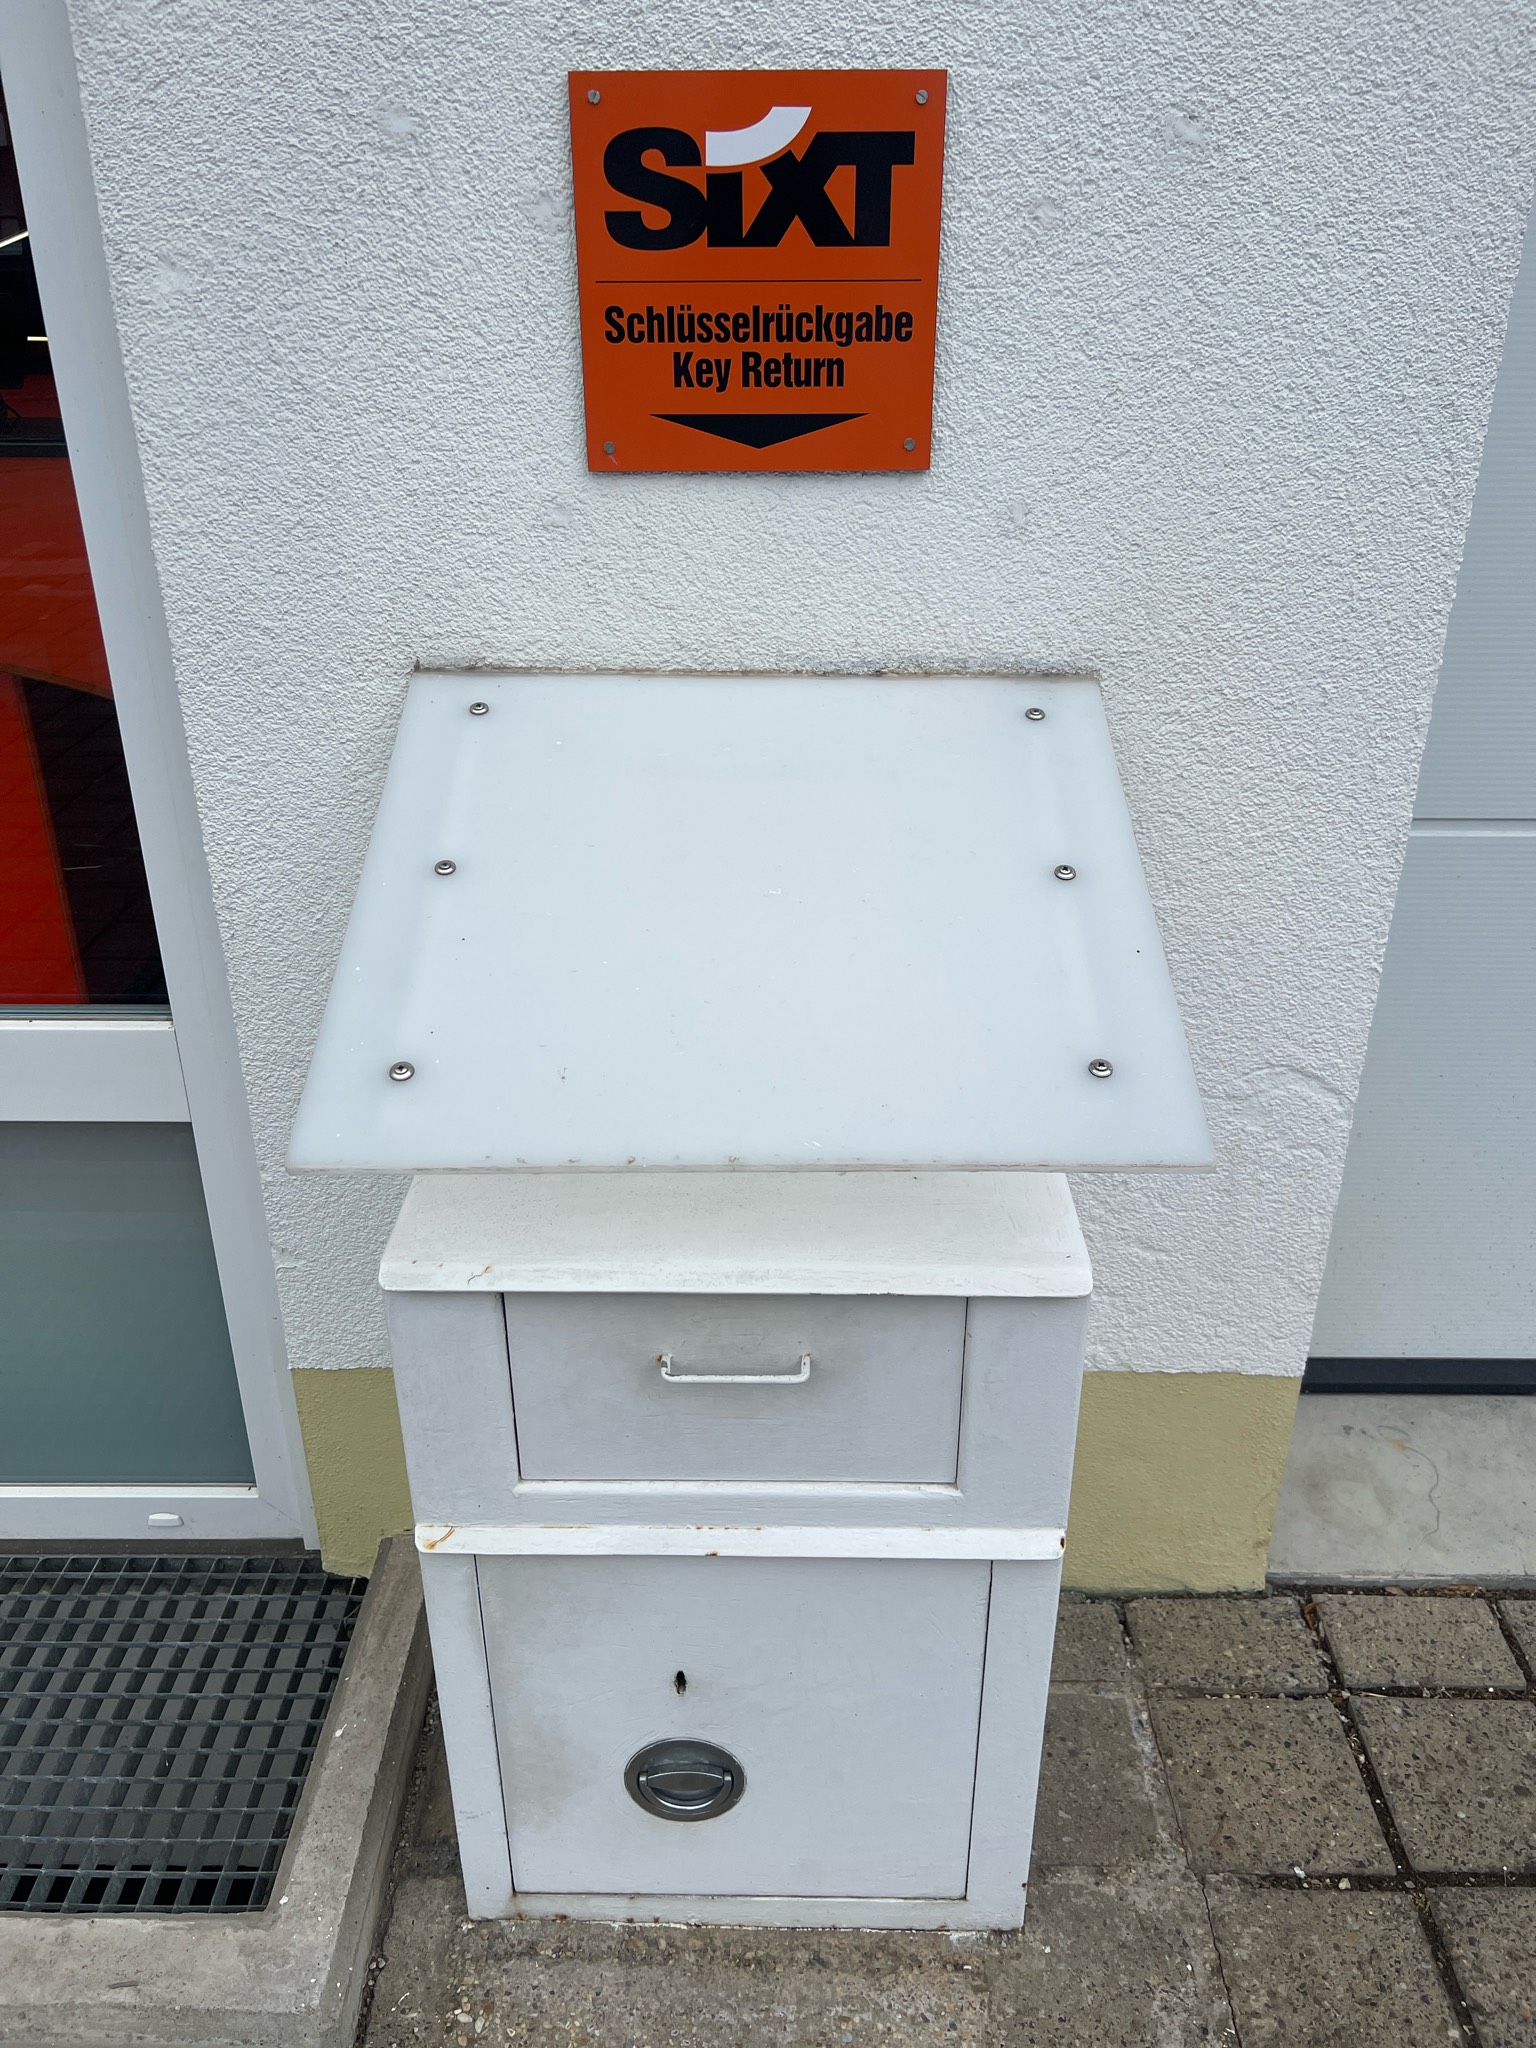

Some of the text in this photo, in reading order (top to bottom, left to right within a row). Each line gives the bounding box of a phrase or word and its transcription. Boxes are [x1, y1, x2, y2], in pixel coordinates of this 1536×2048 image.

[604, 304, 913, 347] Schlüsselrückgabe
[672, 351, 845, 393] Key Return
